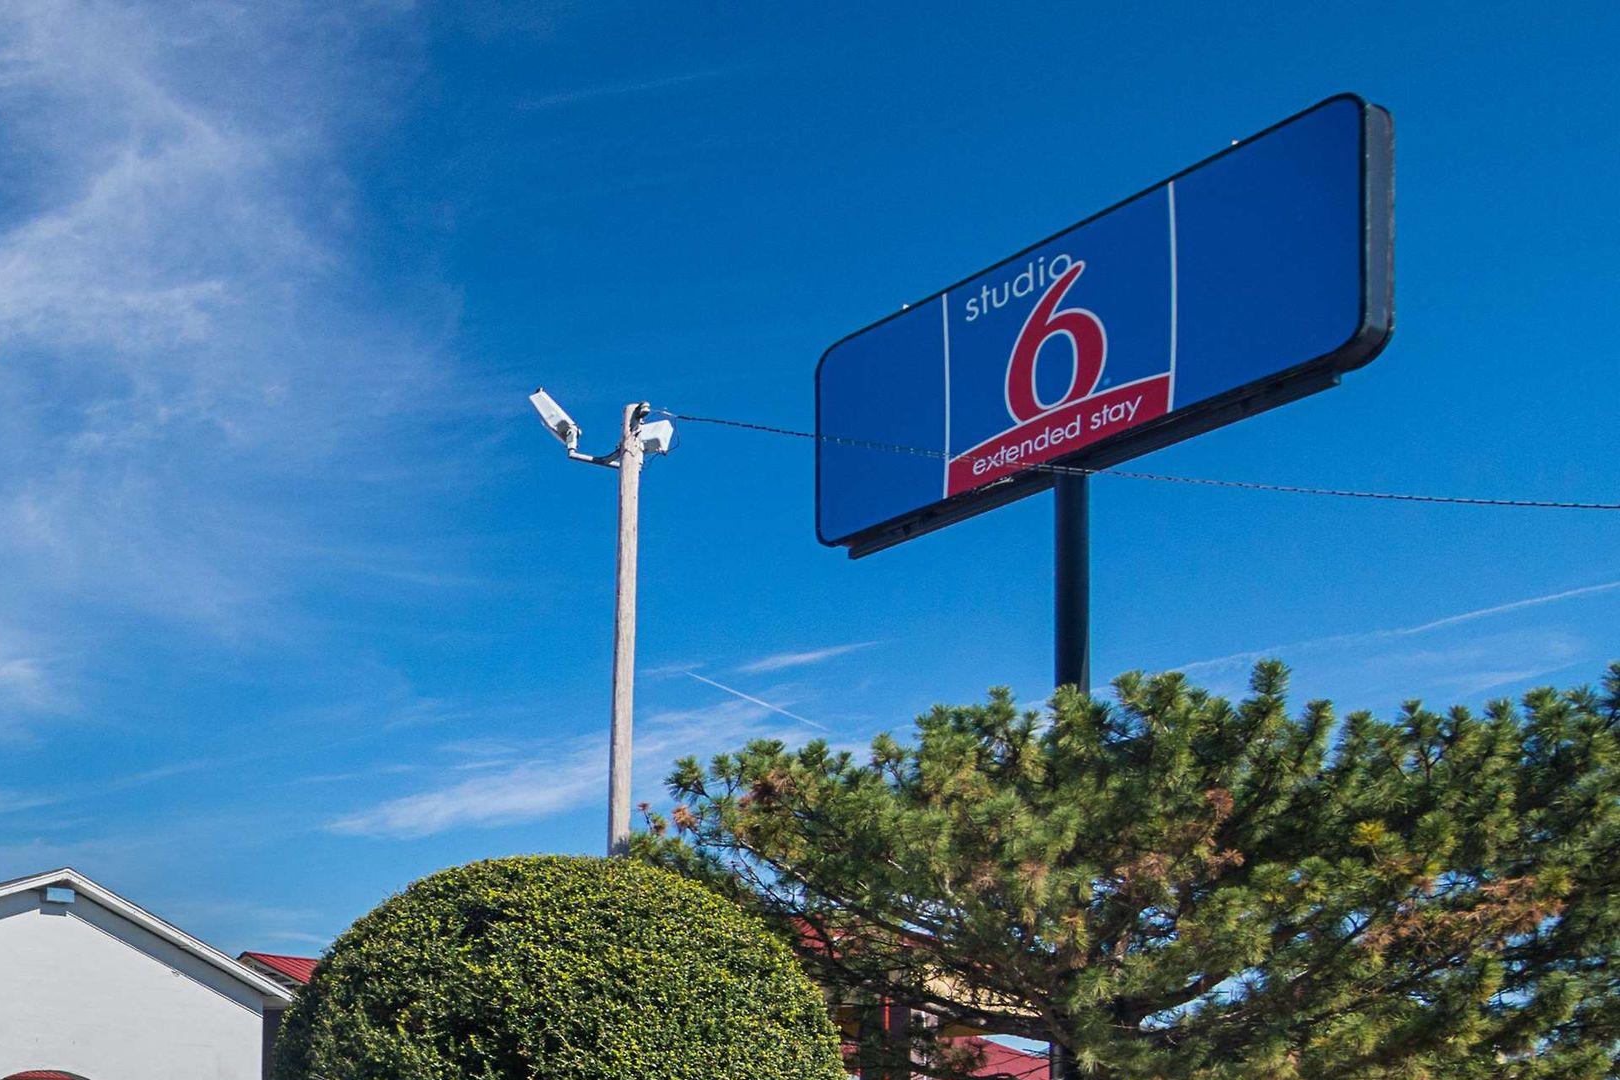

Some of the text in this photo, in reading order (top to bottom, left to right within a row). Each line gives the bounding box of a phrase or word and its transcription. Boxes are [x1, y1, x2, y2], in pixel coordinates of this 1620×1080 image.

[965, 254, 1072, 322] studio
[1004, 260, 1108, 425] 6
[972, 396, 1143, 476] extended stay
